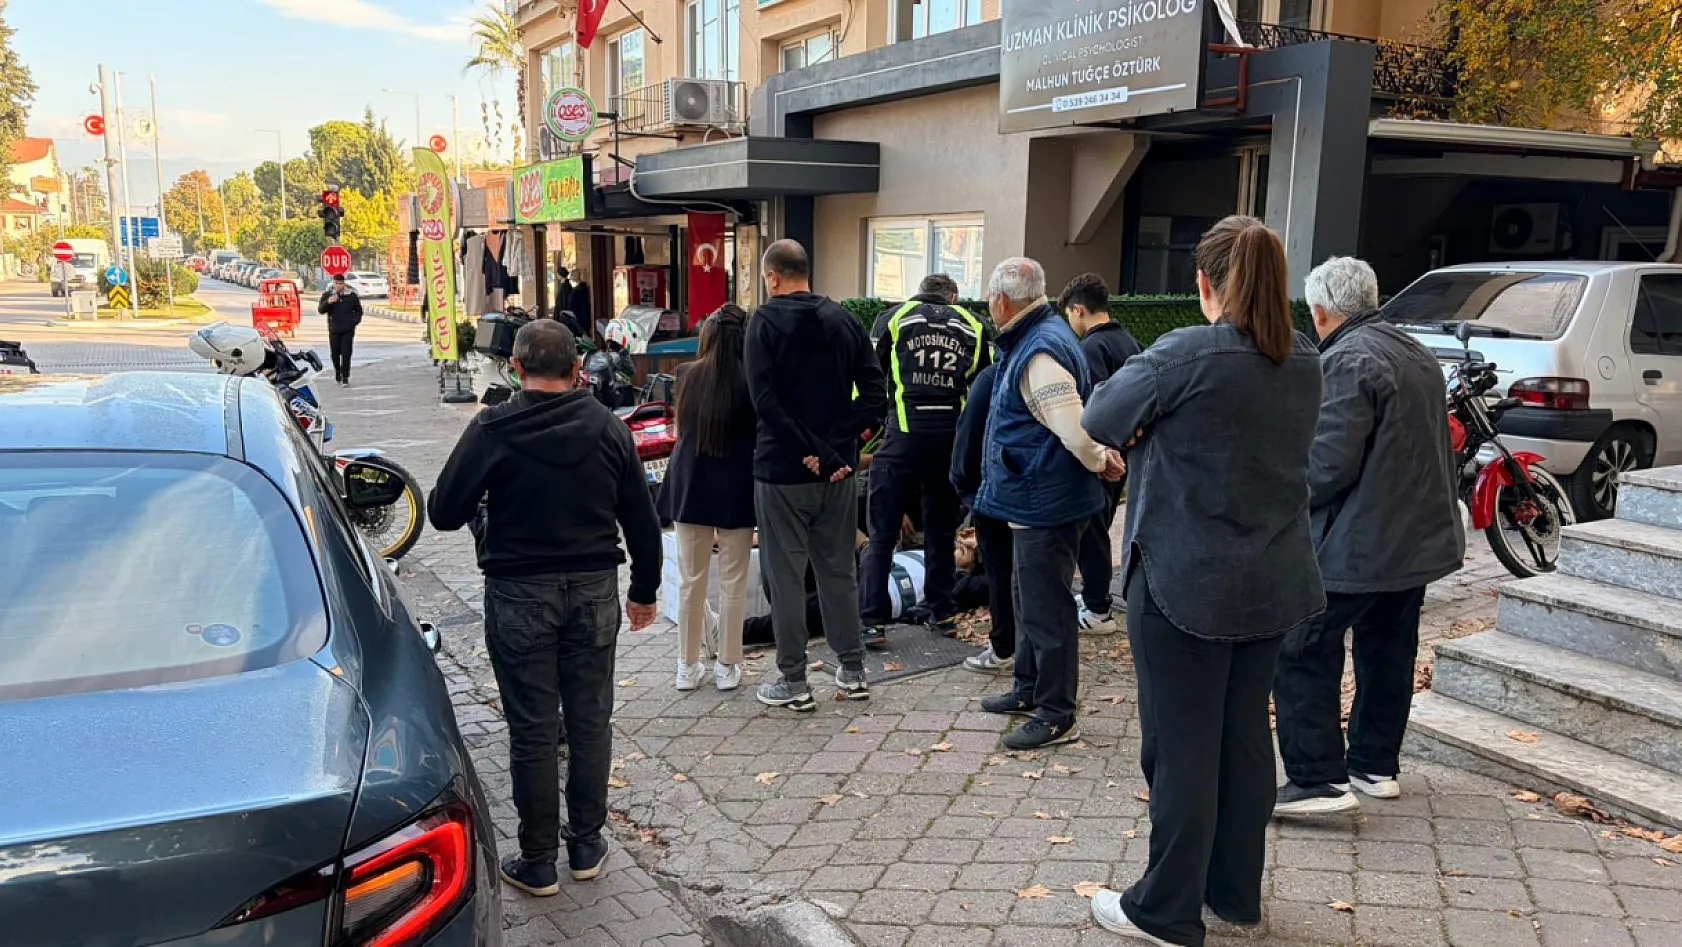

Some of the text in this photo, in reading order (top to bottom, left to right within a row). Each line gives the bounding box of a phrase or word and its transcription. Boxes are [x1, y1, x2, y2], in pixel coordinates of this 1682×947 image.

[1006, 0, 1197, 51] UZMAN KLİNİK PSİKOLOG
[1080, 36, 1143, 57] PSYCHOLOGIST
[1026, 56, 1161, 92] MALHUN TUĞÇE ÖZTÜRK
[324, 254, 349, 267] DUR
[906, 332, 966, 357] MOTOSİKLETLİ
[914, 348, 957, 371] 112
[912, 371, 954, 389] MUĞLA
